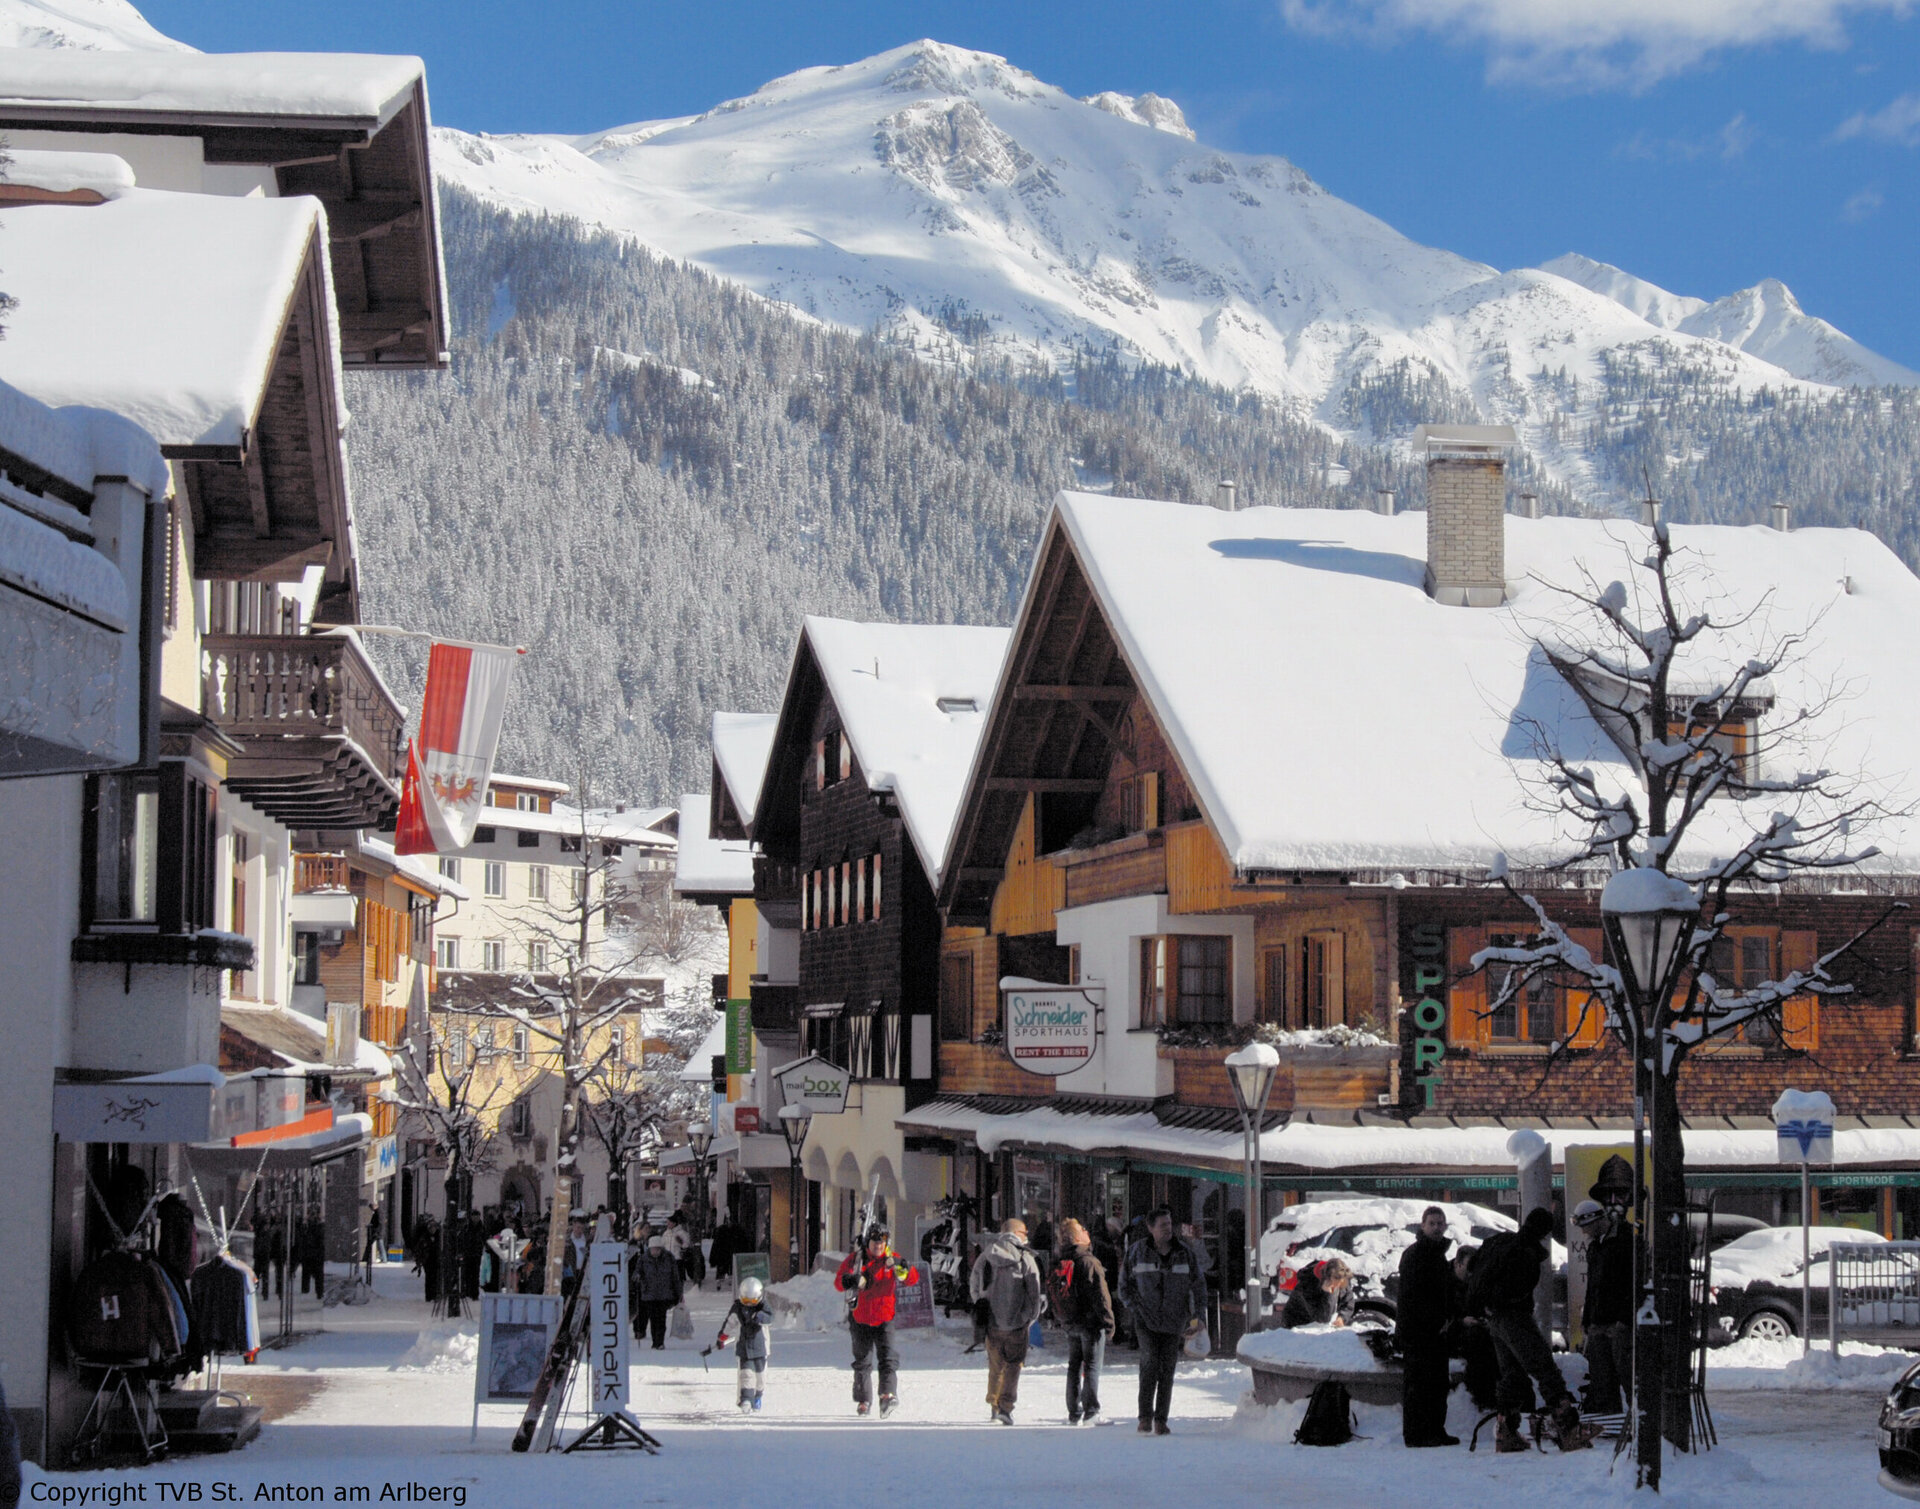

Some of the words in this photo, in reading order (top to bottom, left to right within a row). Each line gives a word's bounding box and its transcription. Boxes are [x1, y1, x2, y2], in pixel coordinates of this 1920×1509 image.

[1013, 996, 1088, 1027] Schneider
[1413, 923, 1445, 1109] SPORT
[1014, 1027, 1088, 1037] SPORTHAUS
[1016, 1048, 1040, 1057] RENT
[1043, 1048, 1061, 1056] THE
[1063, 1047, 1087, 1056] BEST
[1375, 1178, 1422, 1188] SERVICE
[1464, 1178, 1510, 1188] VERLEIH
[1832, 1175, 1895, 1185] SPORTMODE
[602, 1252, 622, 1401] Telemark
